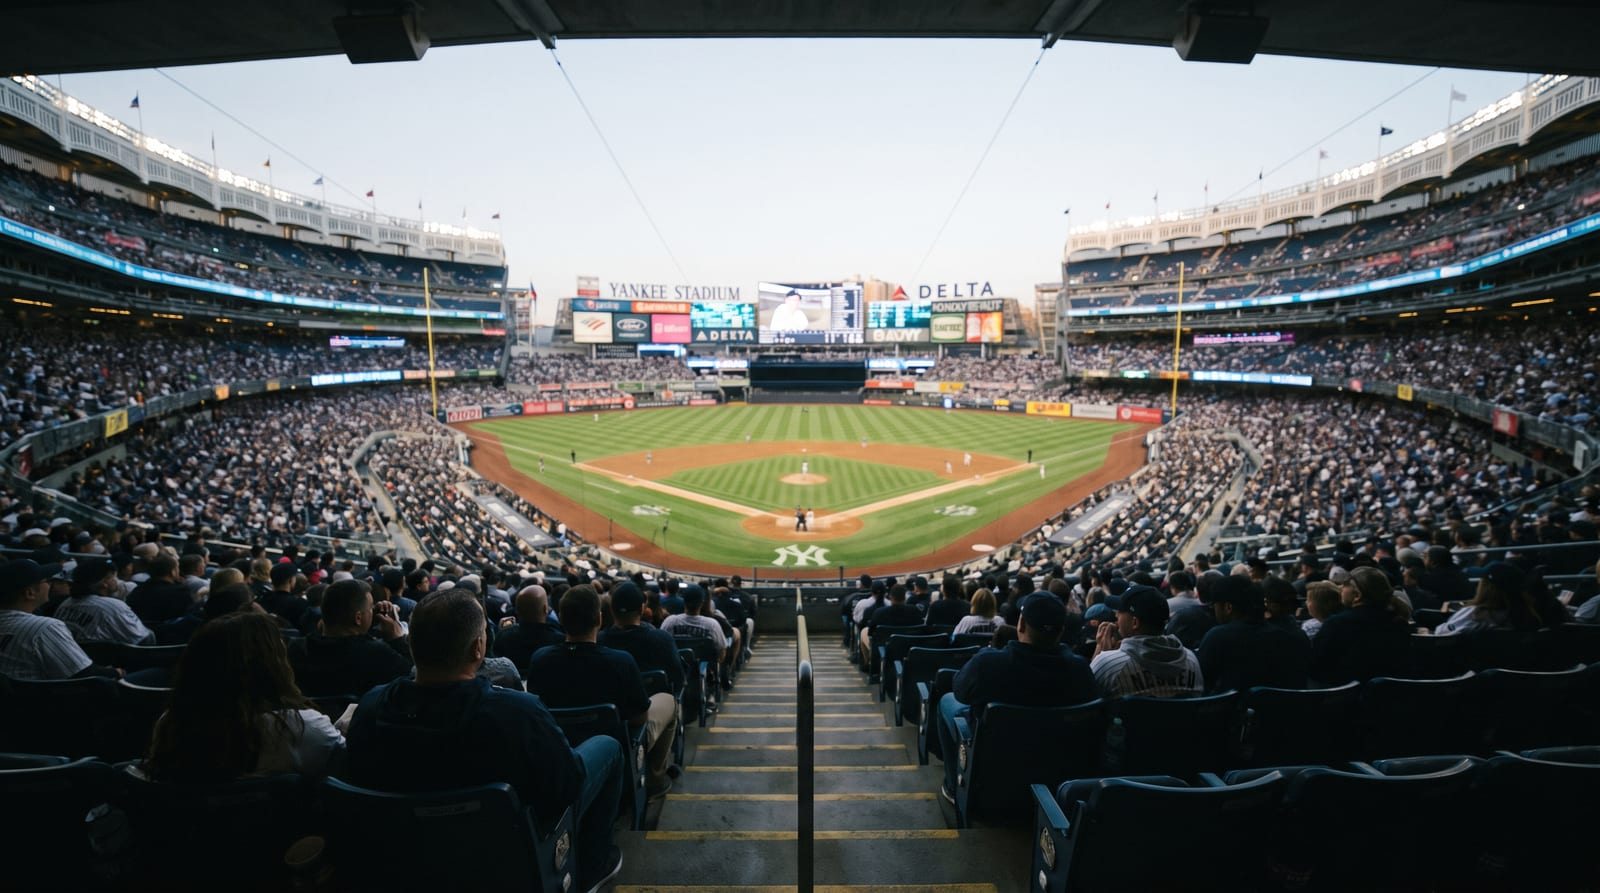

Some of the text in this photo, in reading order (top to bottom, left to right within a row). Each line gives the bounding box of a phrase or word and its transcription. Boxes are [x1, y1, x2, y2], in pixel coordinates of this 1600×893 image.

[610, 282, 740, 300] YANKEE STADIUM
[919, 281, 994, 299] DELTA
